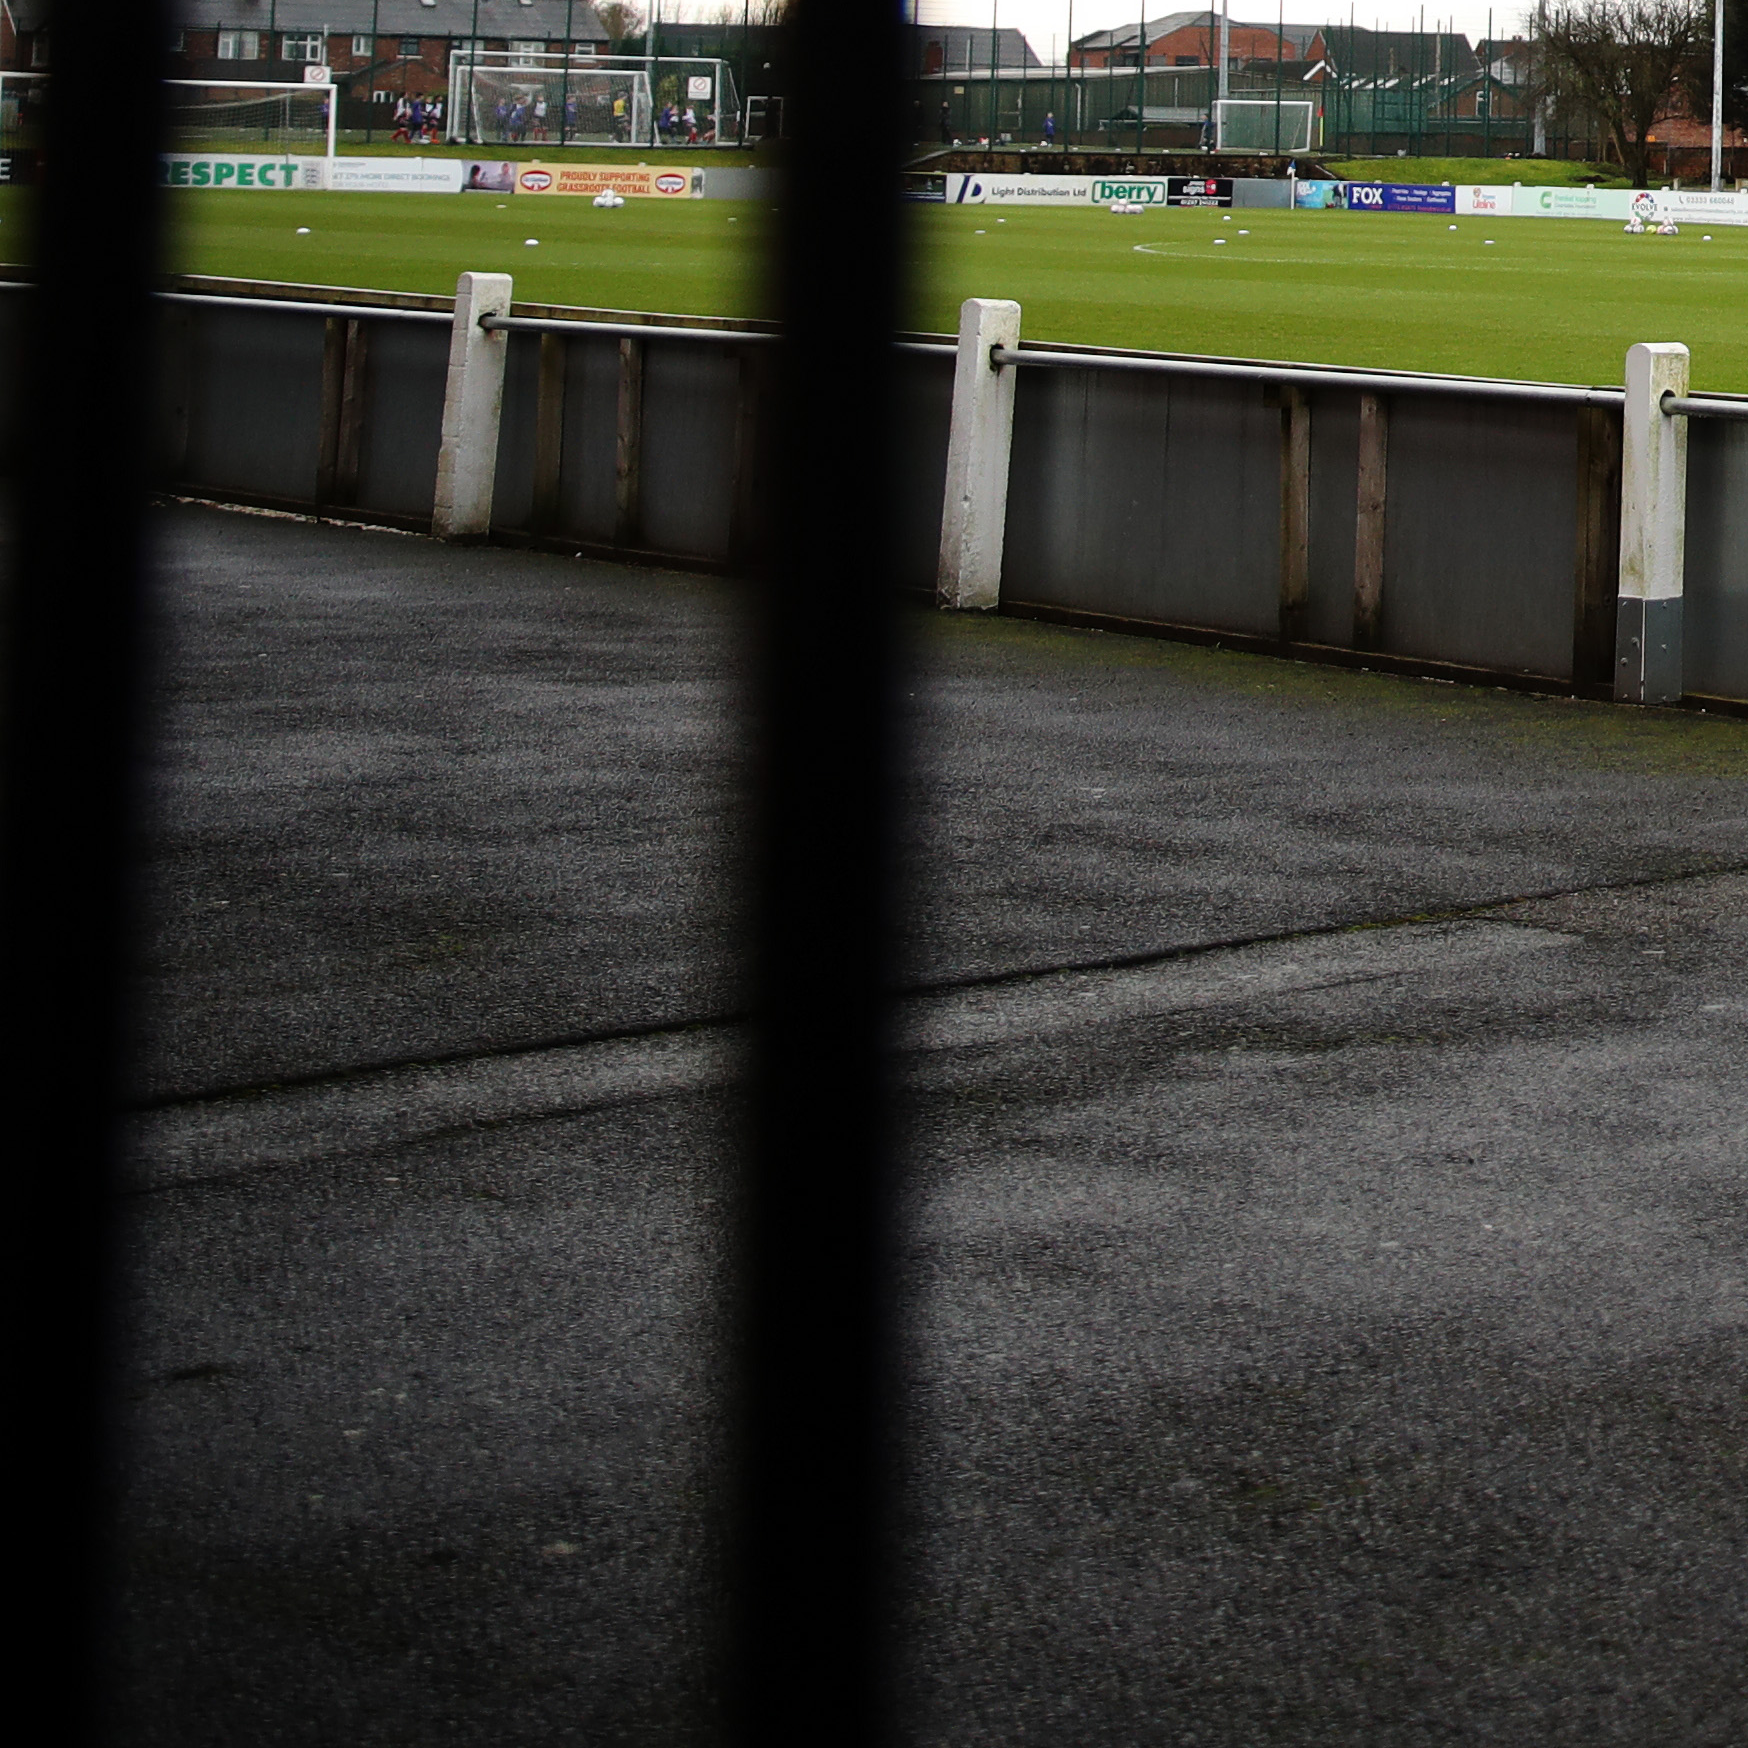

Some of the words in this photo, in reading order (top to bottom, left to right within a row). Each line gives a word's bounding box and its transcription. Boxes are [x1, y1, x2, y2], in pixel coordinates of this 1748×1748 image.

[560, 171, 596, 181] PROUDLY
[599, 172, 650, 182] SUPPORTING
[612, 184, 651, 194] FOOTBALL
[992, 187, 1014, 197] Light
[1017, 188, 1069, 196] Distribution
[1101, 182, 1158, 203] berry
[1352, 187, 1383, 204] FOX
[1632, 203, 1658, 212] EVOLVE
